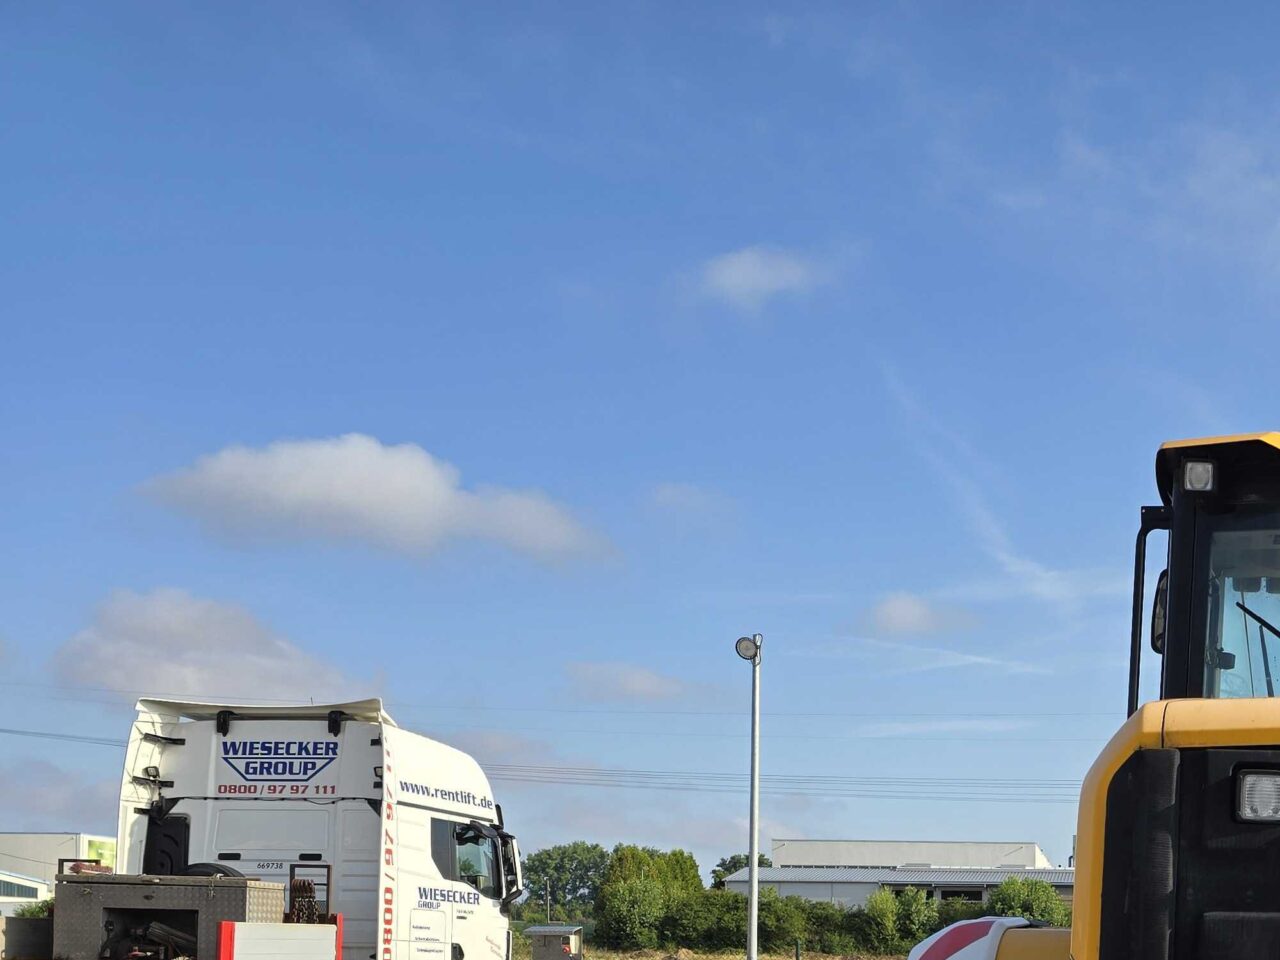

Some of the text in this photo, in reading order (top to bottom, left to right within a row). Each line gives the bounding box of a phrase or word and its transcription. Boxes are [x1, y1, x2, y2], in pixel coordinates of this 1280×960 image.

[221, 741, 339, 756] WIESECKER
[244, 761, 317, 776] GROUP
[217, 784, 258, 795] 0800
[267, 784, 287, 795] 97
[290, 785, 309, 795] 97
[314, 785, 337, 795] 111
[399, 780, 494, 810] www.rentlift.de
[384, 828, 395, 867] 97
[256, 862, 284, 870] 669738
[418, 886, 480, 905] WIESECKER
[417, 900, 441, 910] GROUP
